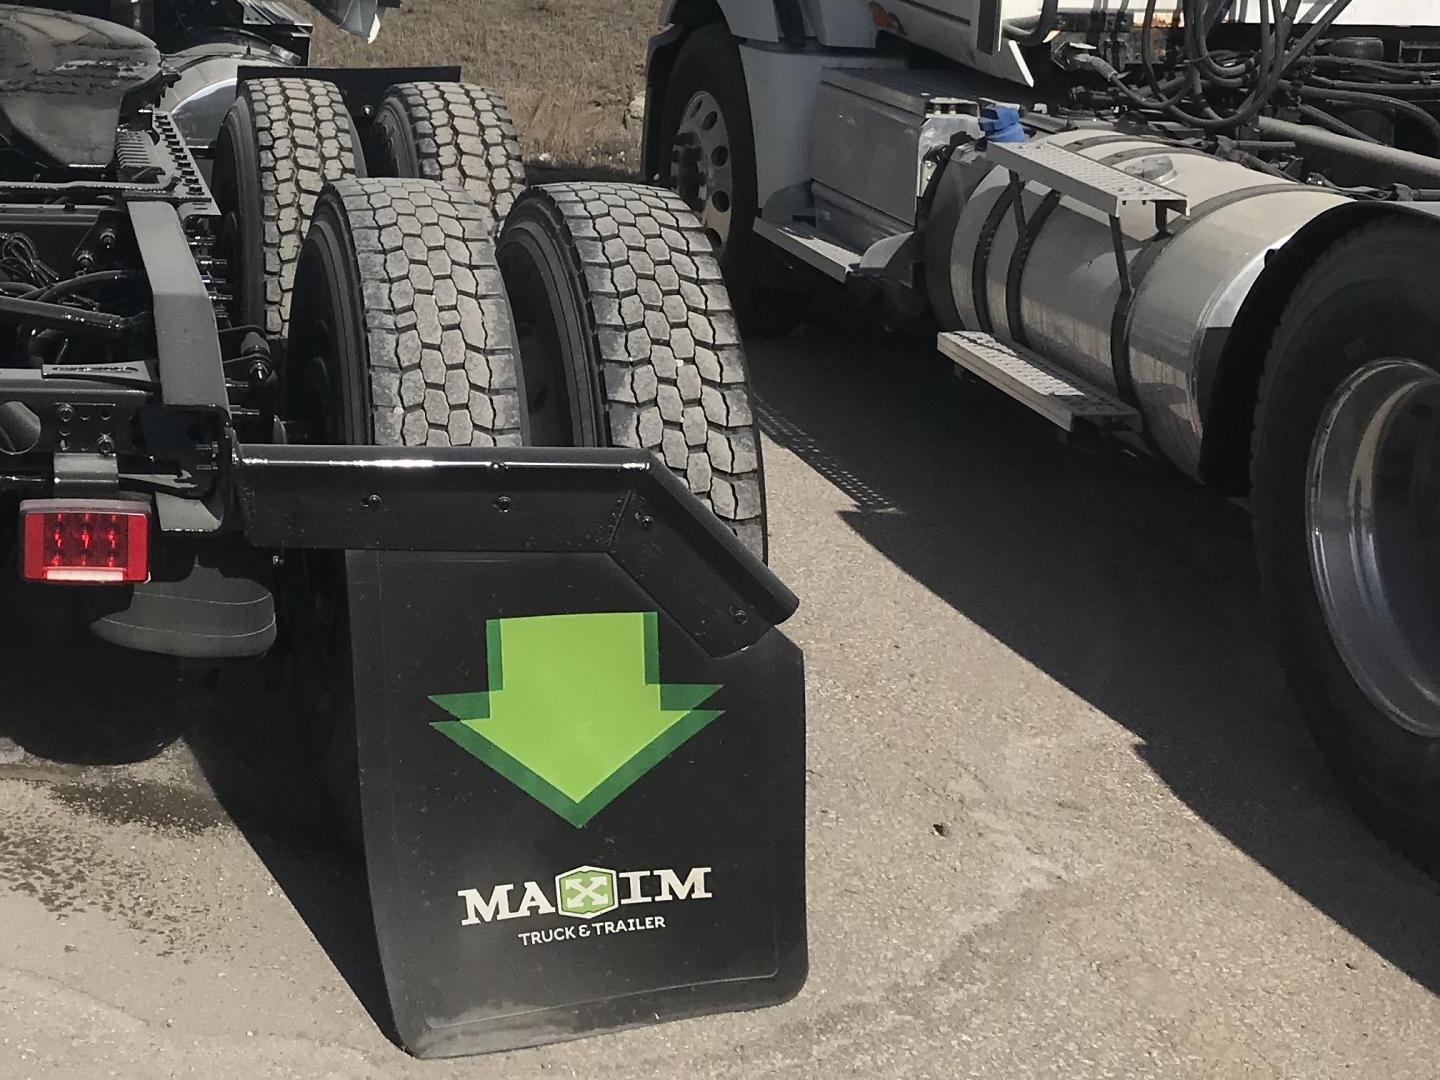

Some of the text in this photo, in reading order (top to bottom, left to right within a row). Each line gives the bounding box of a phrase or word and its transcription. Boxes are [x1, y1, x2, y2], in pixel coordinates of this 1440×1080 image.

[457, 865, 713, 927] MAXIM
[517, 915, 666, 946] TRUCK & TRAILER
